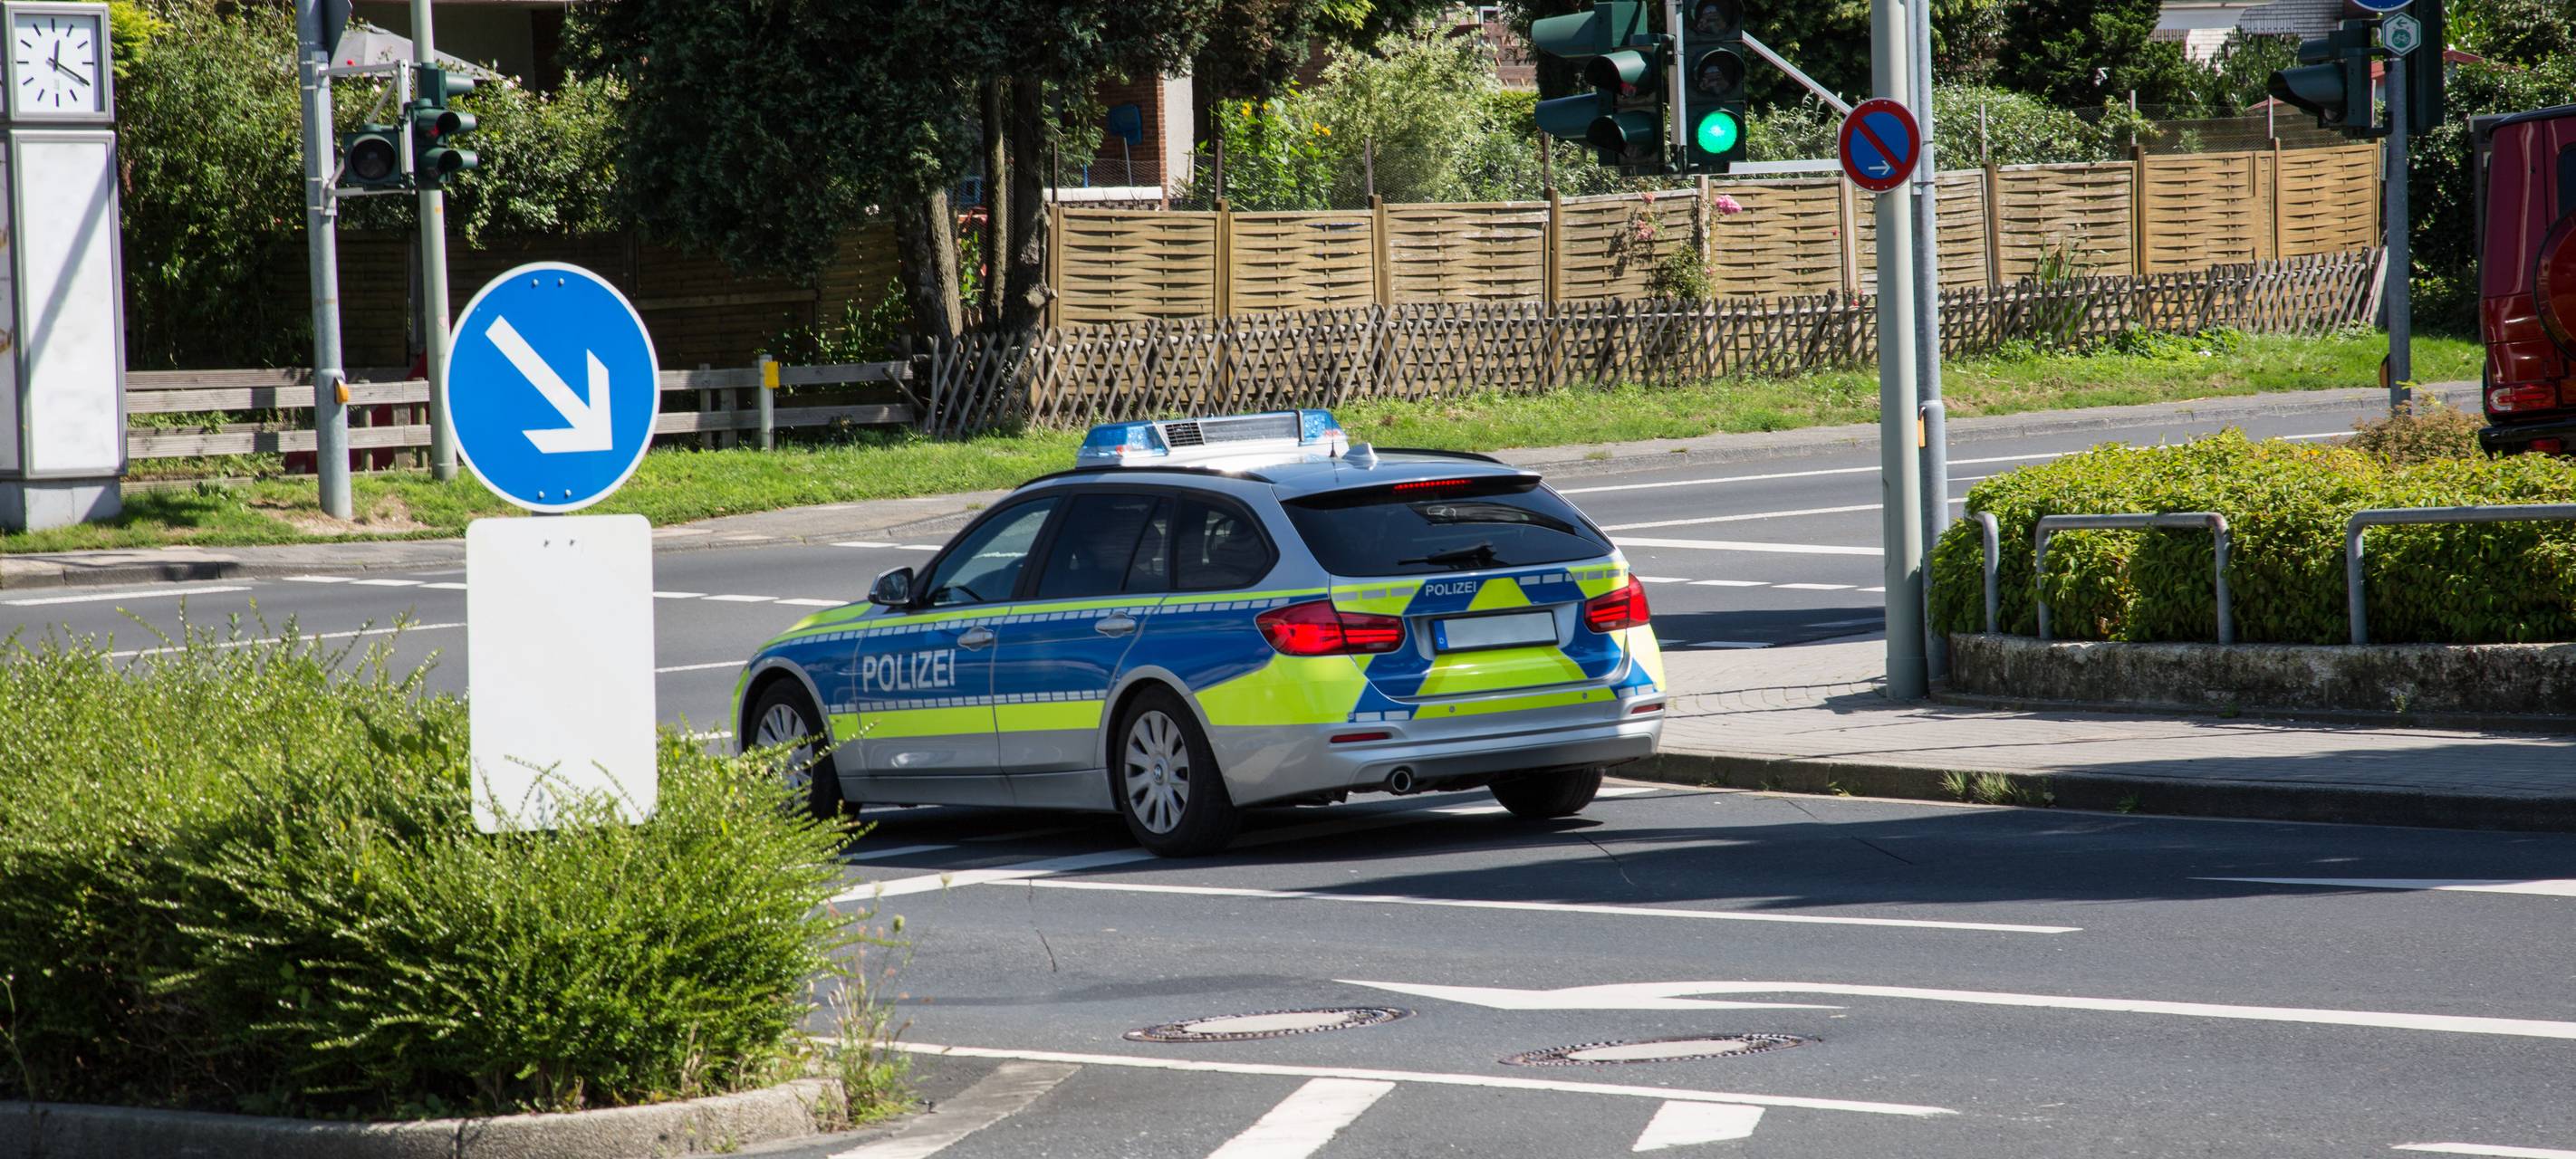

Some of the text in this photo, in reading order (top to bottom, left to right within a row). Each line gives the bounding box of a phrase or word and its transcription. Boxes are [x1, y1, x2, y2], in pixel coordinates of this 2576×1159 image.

[1425, 581, 1476, 597] POLIZEI
[1438, 637, 1446, 645] D
[862, 648, 956, 693] POLIZEI
